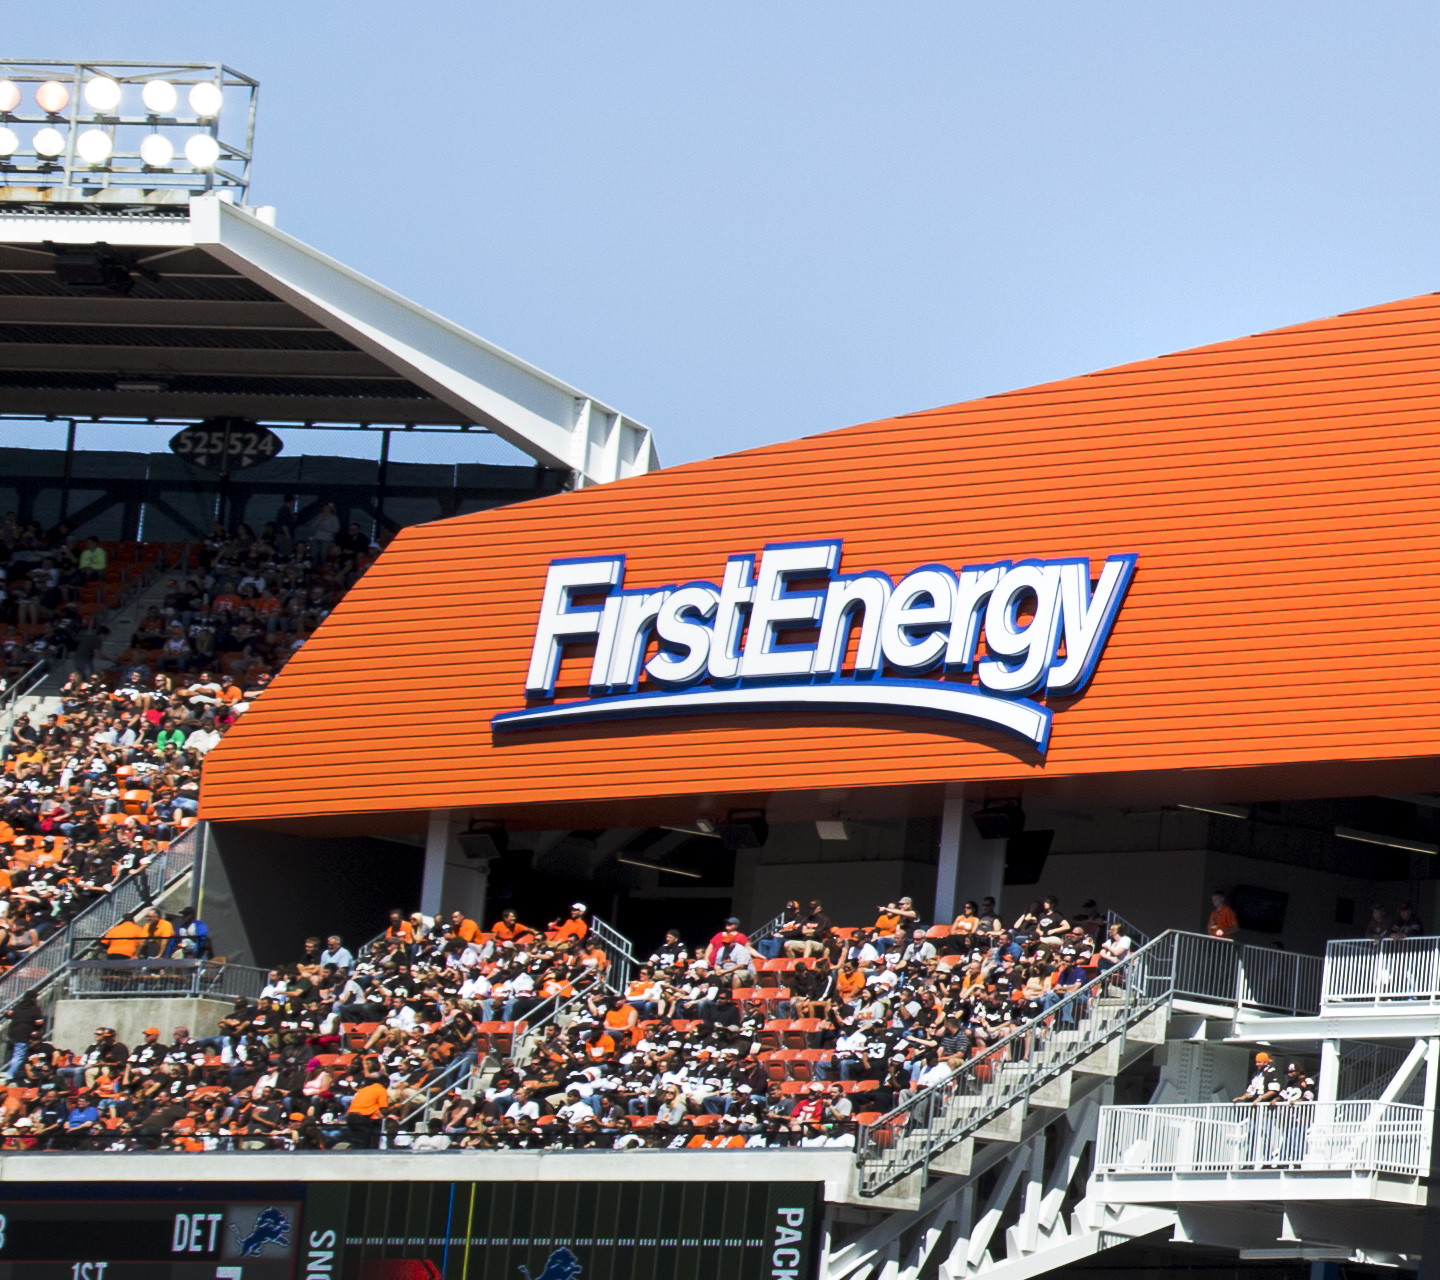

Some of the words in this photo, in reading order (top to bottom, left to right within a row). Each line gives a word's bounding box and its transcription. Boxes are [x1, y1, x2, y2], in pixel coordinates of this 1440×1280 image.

[178, 431, 224, 454] 525
[227, 432, 274, 456] 524
[525, 538, 1138, 697] FirstEnergy
[172, 1213, 223, 1252] DET
